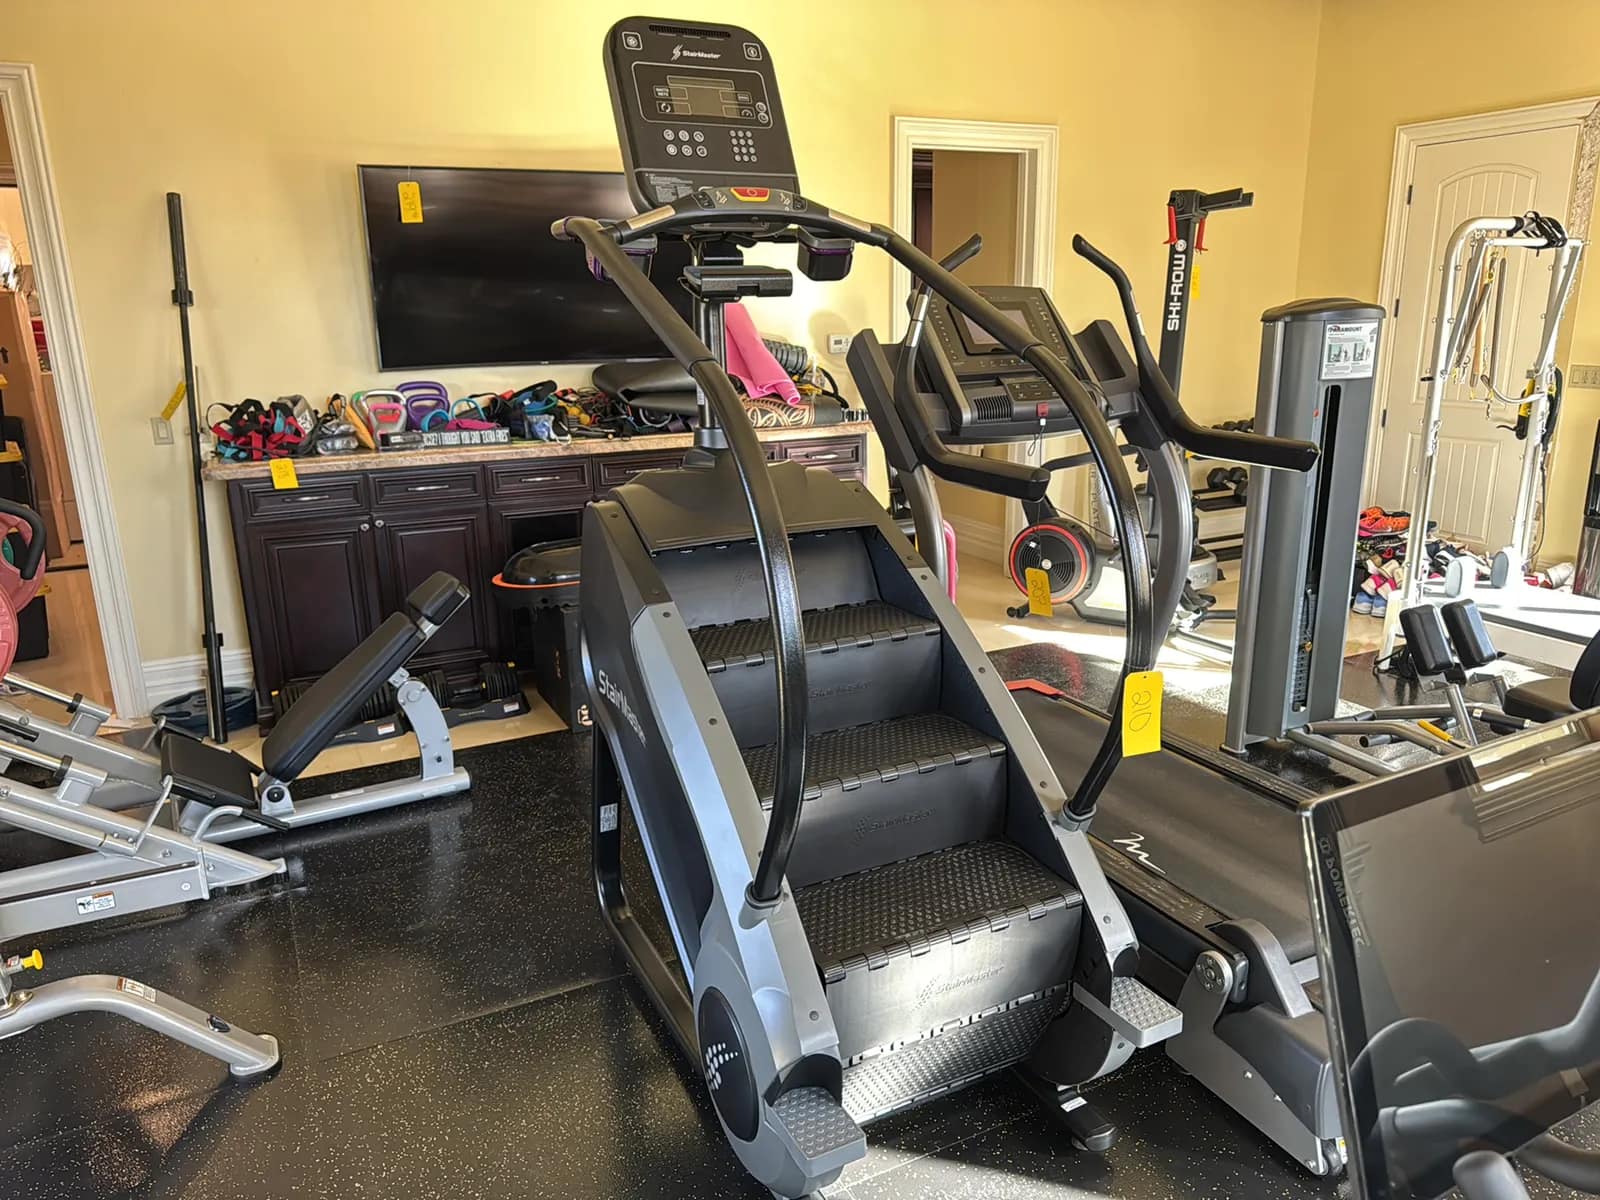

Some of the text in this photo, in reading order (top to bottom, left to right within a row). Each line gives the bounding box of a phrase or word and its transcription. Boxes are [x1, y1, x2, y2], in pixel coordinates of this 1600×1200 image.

[682, 50, 721, 59] StairMaster
[1167, 253, 1186, 331] SKI-ROW
[1129, 690, 1152, 732] 210
